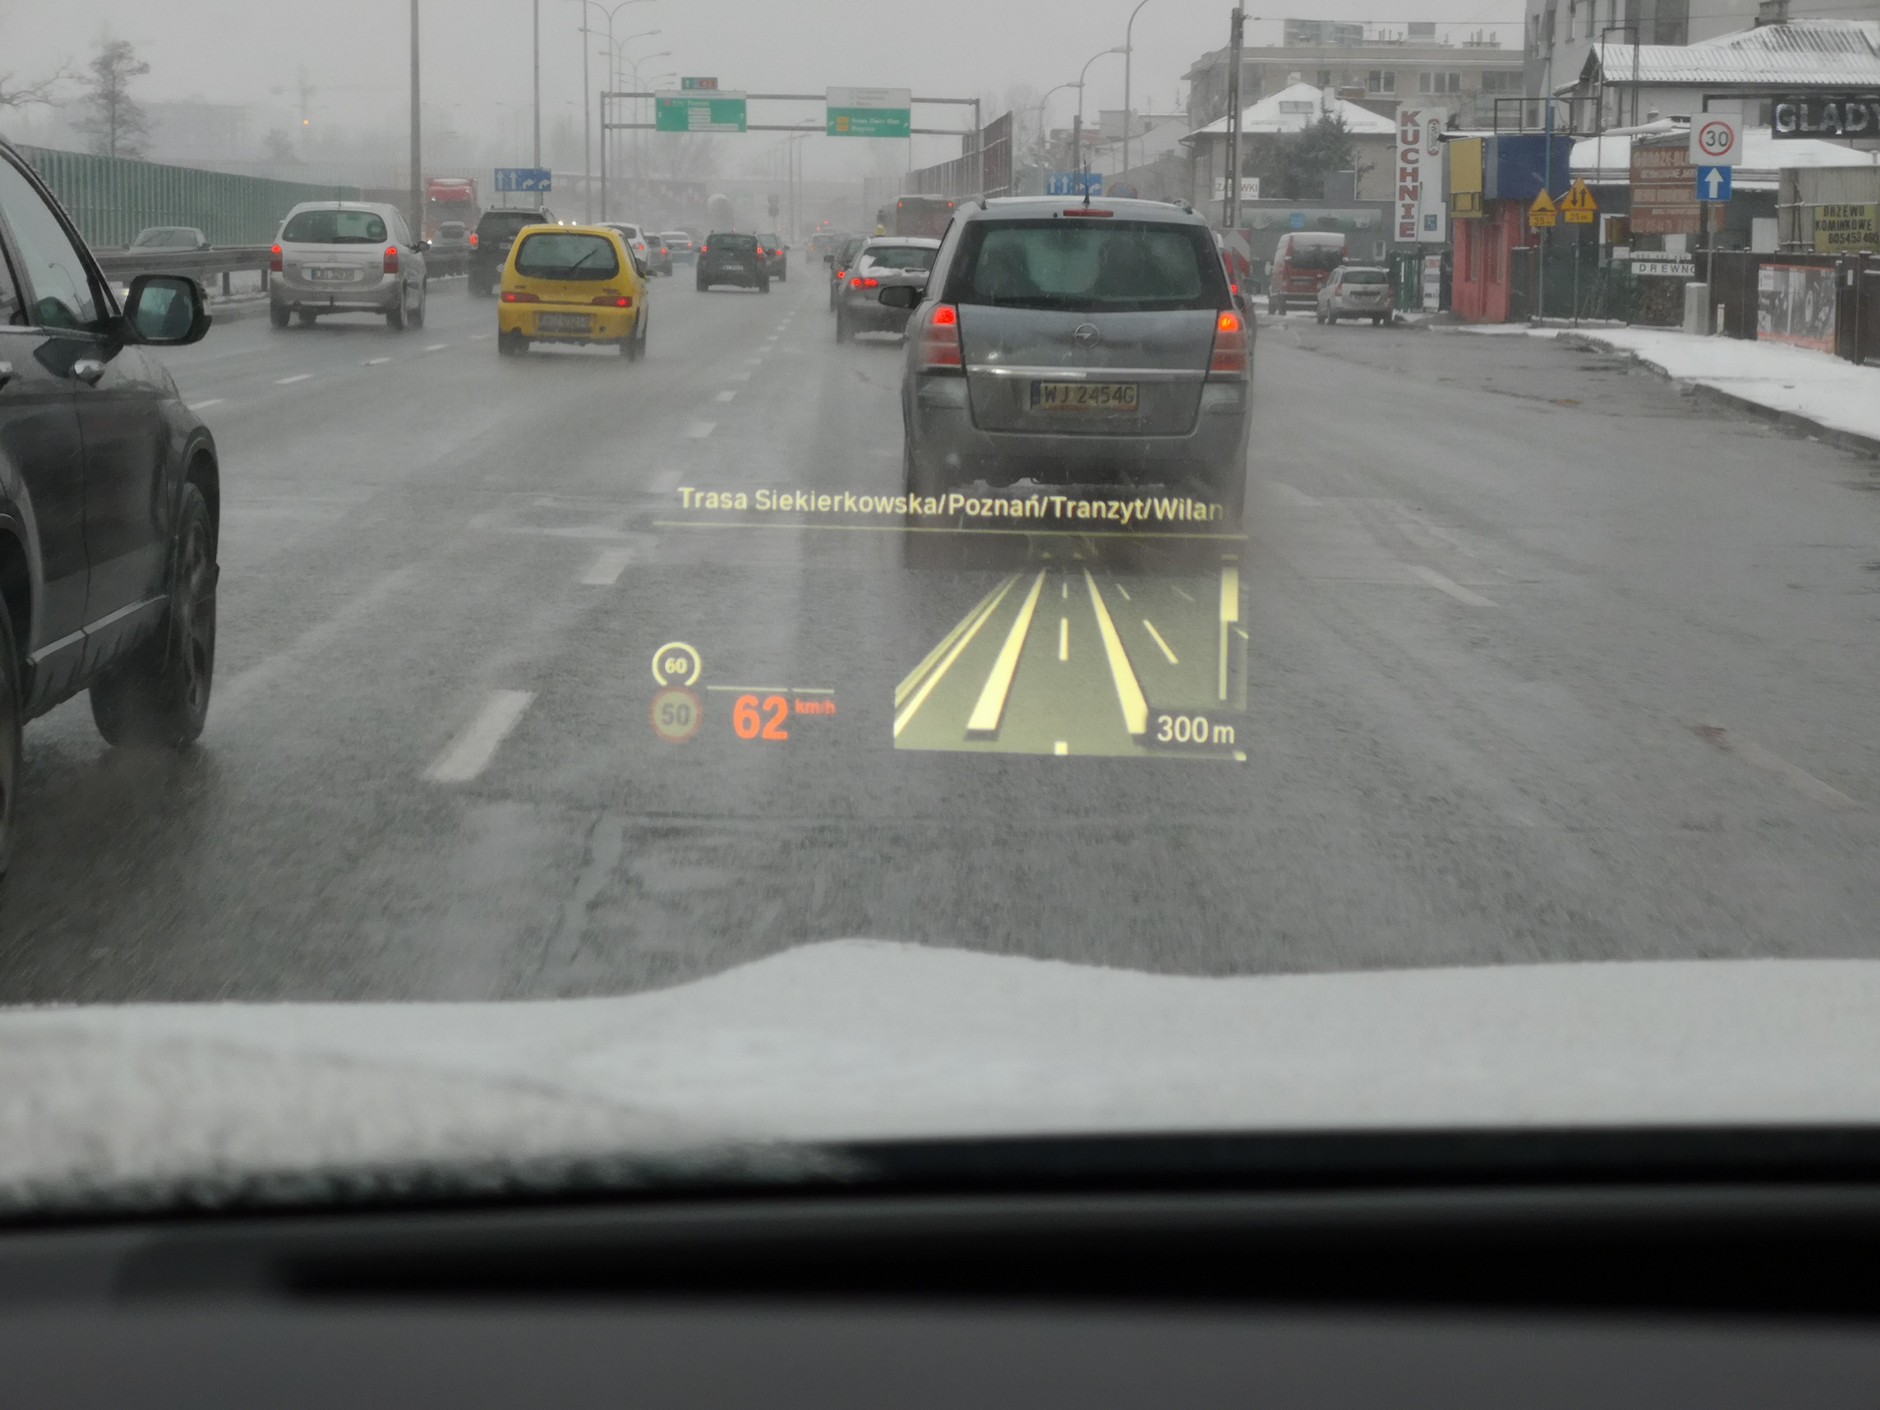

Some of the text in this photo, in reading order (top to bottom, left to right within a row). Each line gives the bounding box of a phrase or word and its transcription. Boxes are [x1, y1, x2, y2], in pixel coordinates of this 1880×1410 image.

[1705, 130, 1729, 146] 30
[1399, 110, 1422, 238] KUCHNIE
[1815, 219, 1872, 231] KOMINKOWE
[678, 486, 748, 510] Trasa
[664, 657, 688, 674] 60
[661, 703, 690, 726] 50
[733, 694, 836, 740] 62 km/h
[1157, 714, 1235, 744] 300 m
